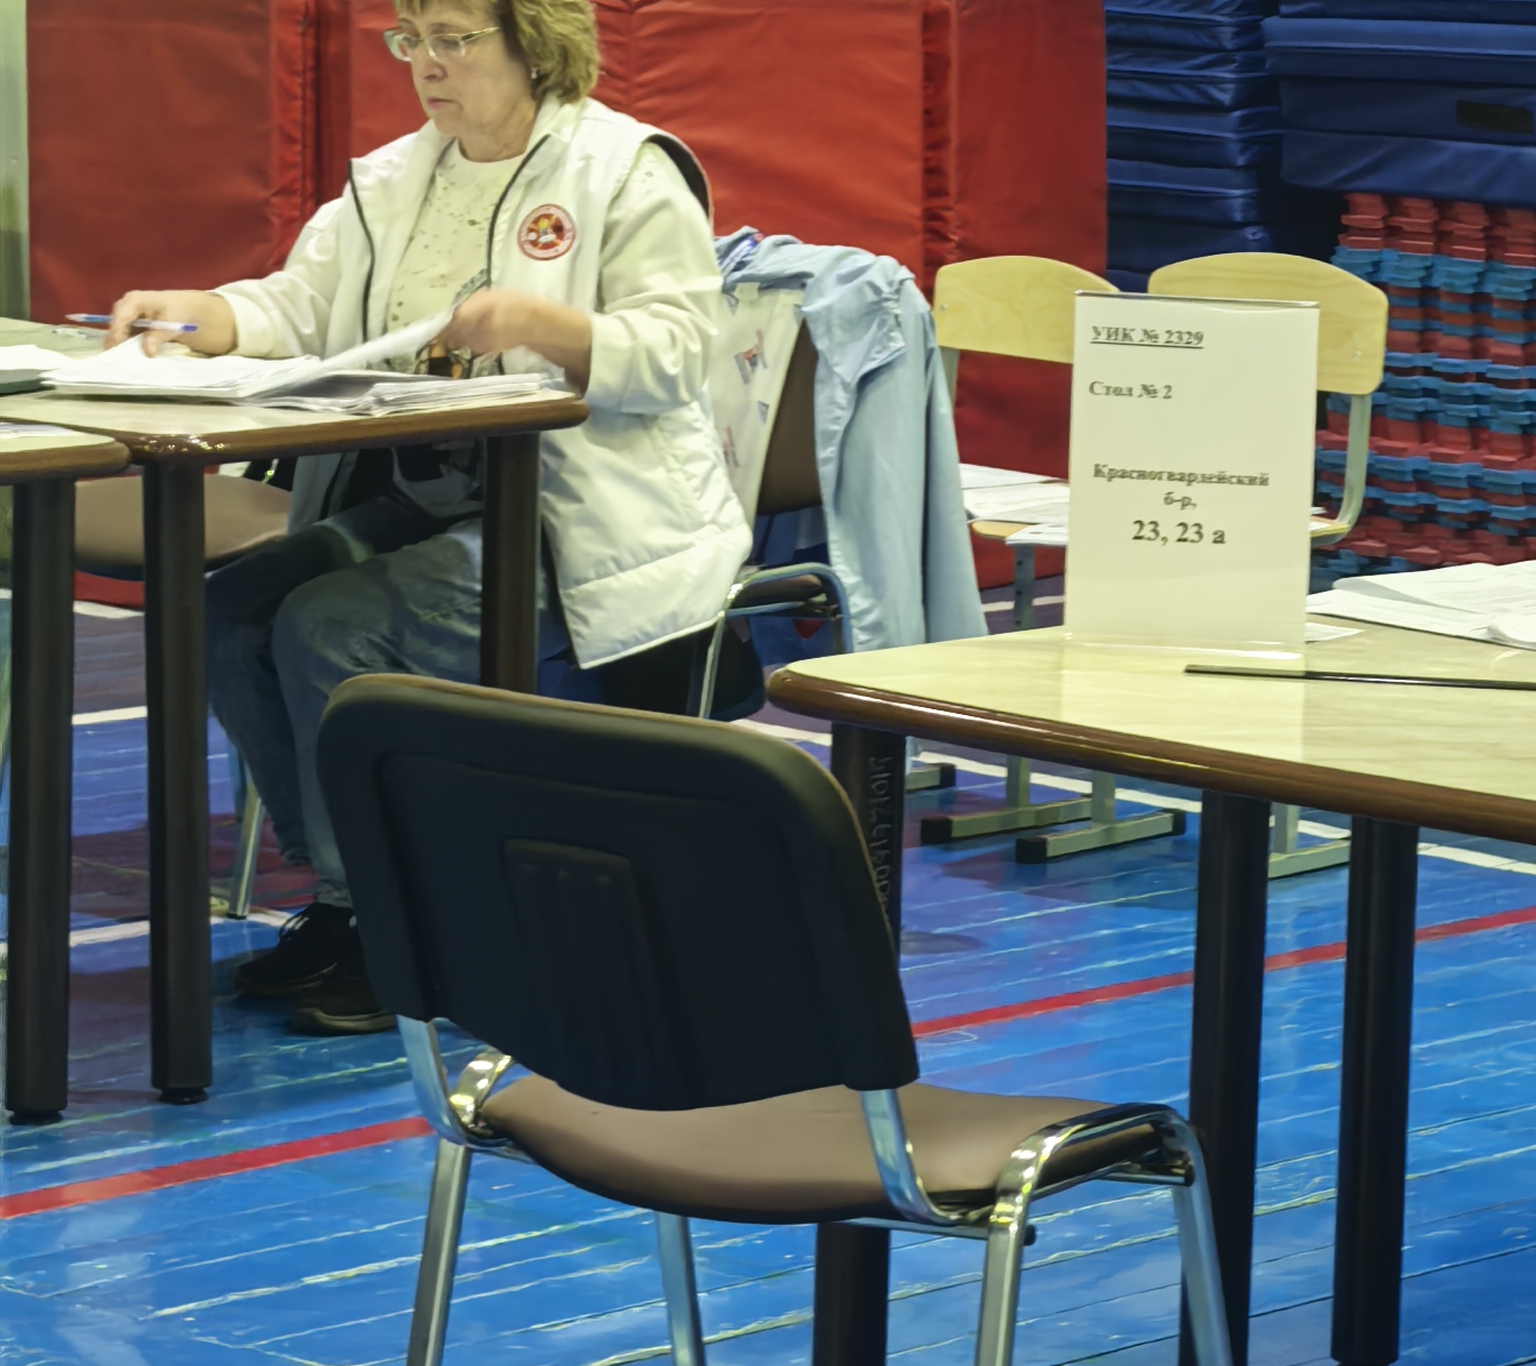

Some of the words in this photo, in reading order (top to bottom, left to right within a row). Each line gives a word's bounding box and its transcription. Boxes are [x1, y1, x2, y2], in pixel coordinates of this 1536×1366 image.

[1091, 325, 1136, 342] УИК
[1138, 328, 1160, 344] №
[1088, 380, 1134, 397] Стол
[1137, 383, 1159, 399] №
[1162, 384, 1173, 400] 2
[1093, 463, 1270, 487] Красногвардейский
[1131, 520, 1169, 546] 23,
[1175, 521, 1205, 544] 23
